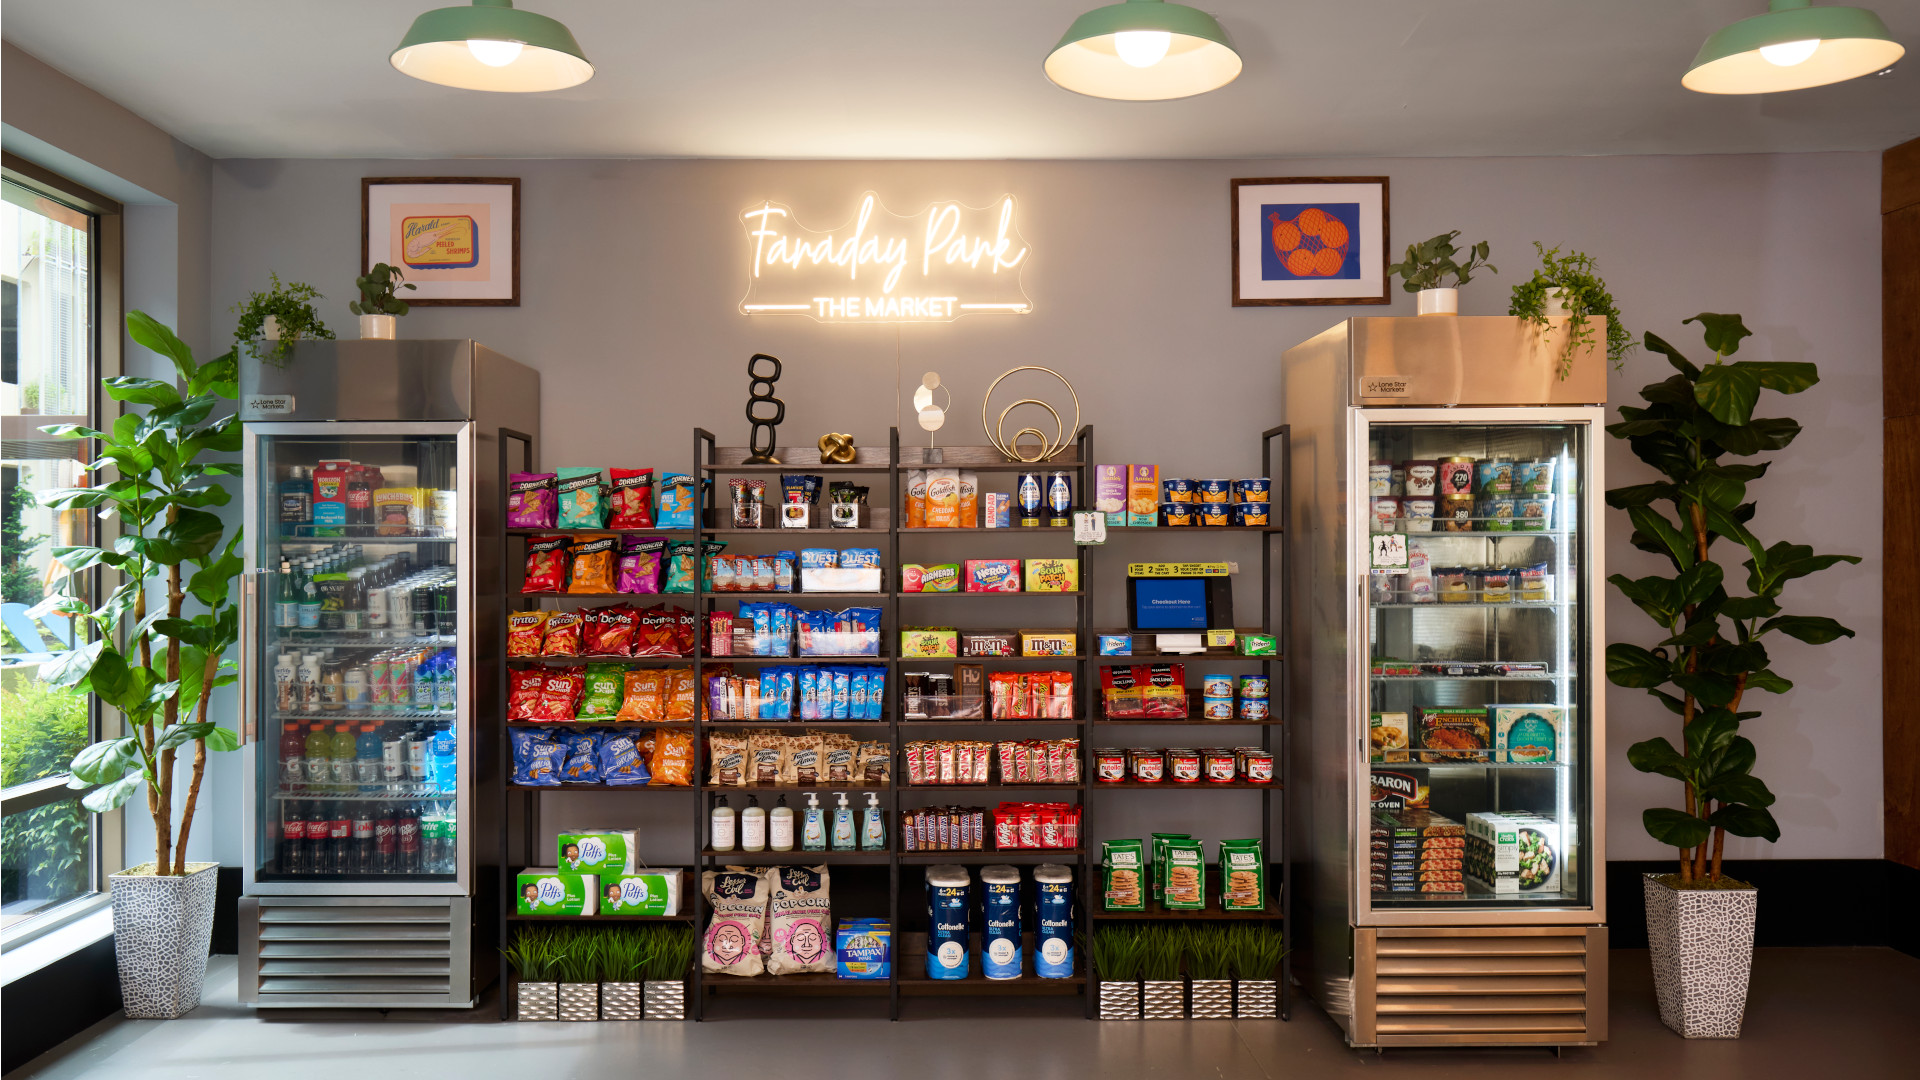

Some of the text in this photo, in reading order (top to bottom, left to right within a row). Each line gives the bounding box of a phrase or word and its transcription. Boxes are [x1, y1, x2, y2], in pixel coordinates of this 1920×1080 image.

[406, 219, 439, 239] Harald
[745, 195, 1026, 293] Faraday Park
[813, 296, 958, 317] THE MARKET
[930, 485, 955, 497] Goldfish
[376, 493, 413, 502] LUNCHABLES
[802, 552, 838, 564] QUEST
[841, 552, 880, 564] QUEST
[921, 568, 955, 584] AIRHEADS
[1040, 567, 1064, 575] SOUR
[1040, 574, 1065, 582] PATCH
[601, 615, 632, 624] Doritos
[643, 617, 675, 625] Doritos
[1106, 640, 1126, 648] Trident
[1435, 717, 1481, 726] ENCHILADA
[908, 748, 920, 780] TWIX
[924, 747, 936, 778] TWIX
[959, 748, 970, 777] TWIX
[1000, 746, 1011, 777] TWIX
[1016, 749, 1027, 778] TWIX
[1037, 751, 1048, 782] TWIX
[1049, 747, 1061, 777] TWIX
[581, 842, 602, 859] Puffs
[1175, 850, 1196, 858] TATE'S
[540, 883, 561, 899] Puffs
[623, 883, 644, 900] Puffs
[946, 888, 956, 896] 24
[996, 885, 1006, 893] 24
[938, 923, 964, 931] Cottonelle
[1042, 919, 1067, 927] Cottonelle
[846, 948, 881, 957] TAMPAX
